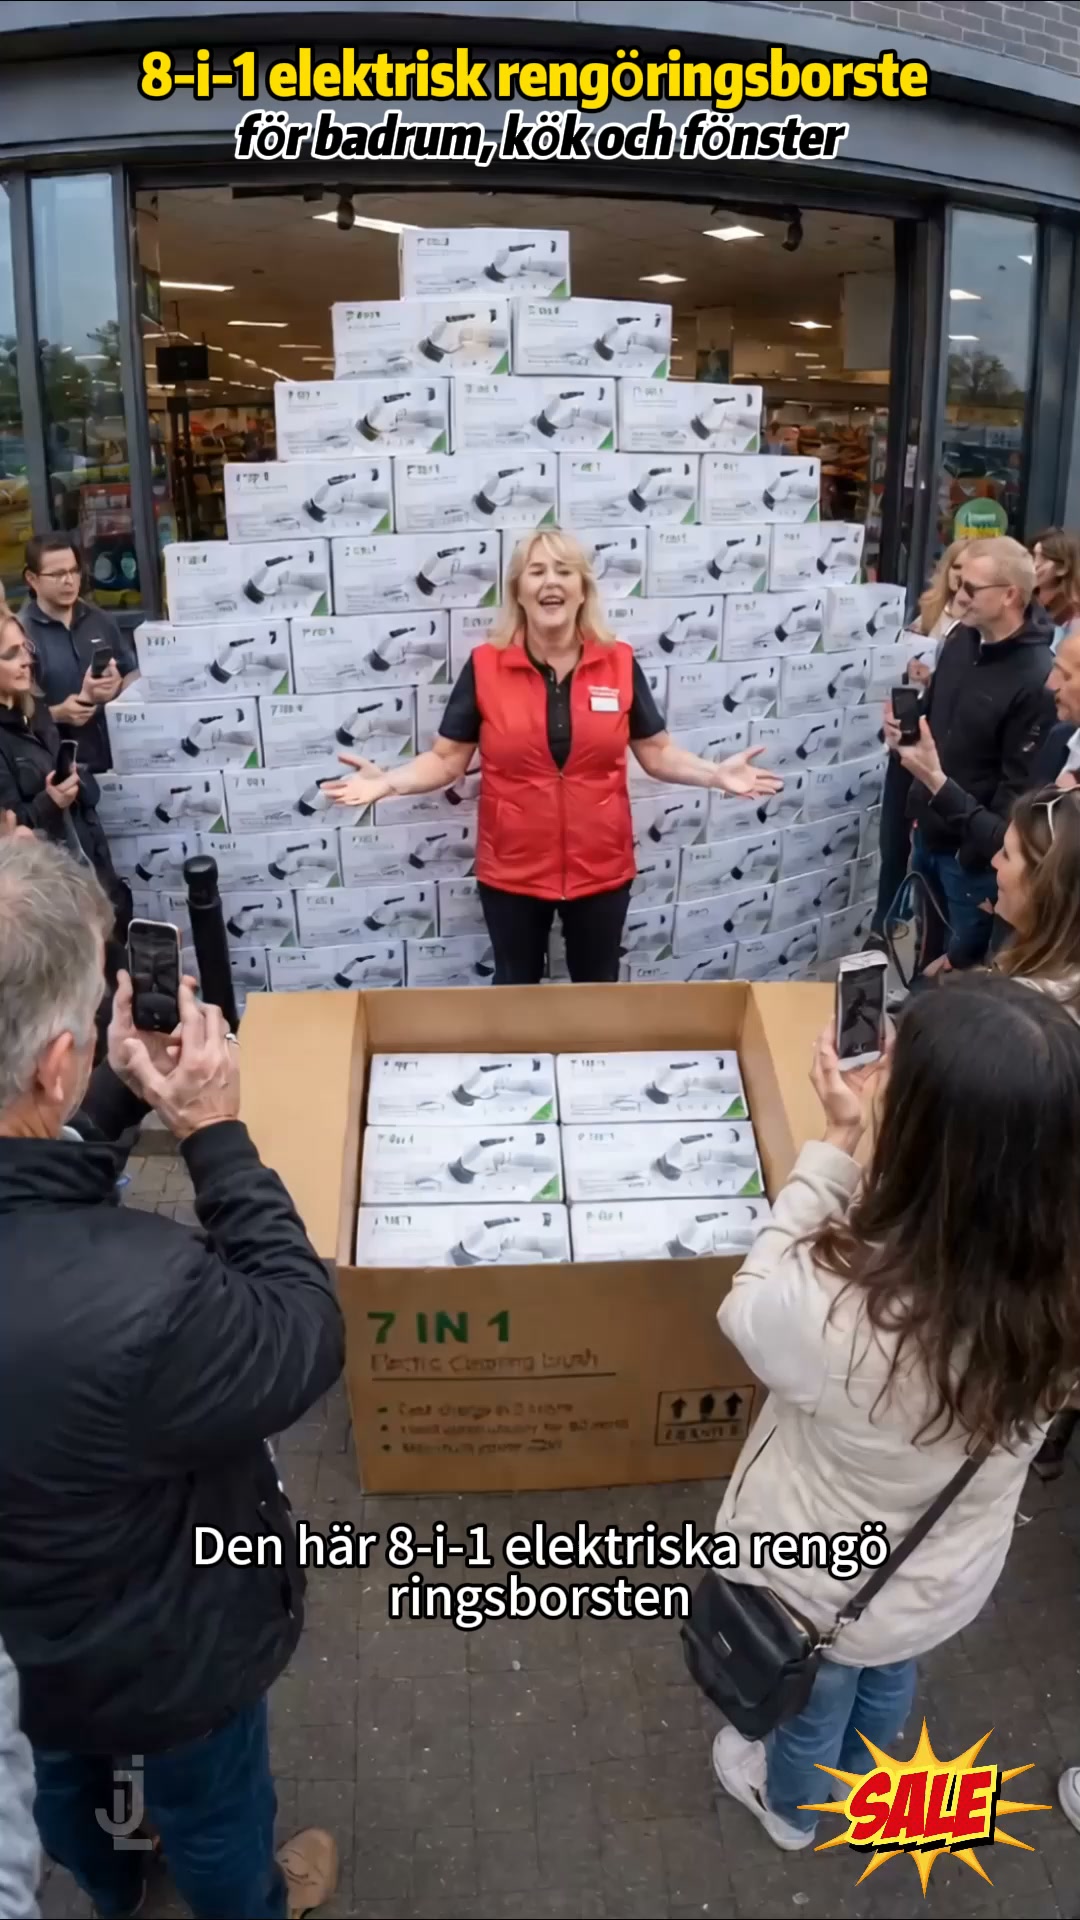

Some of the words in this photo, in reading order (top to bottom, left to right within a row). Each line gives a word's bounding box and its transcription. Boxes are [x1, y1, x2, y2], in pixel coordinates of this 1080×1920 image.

[367, 1311, 396, 1345] 7
[416, 1310, 469, 1344] IN
[487, 1309, 510, 1343] 1
